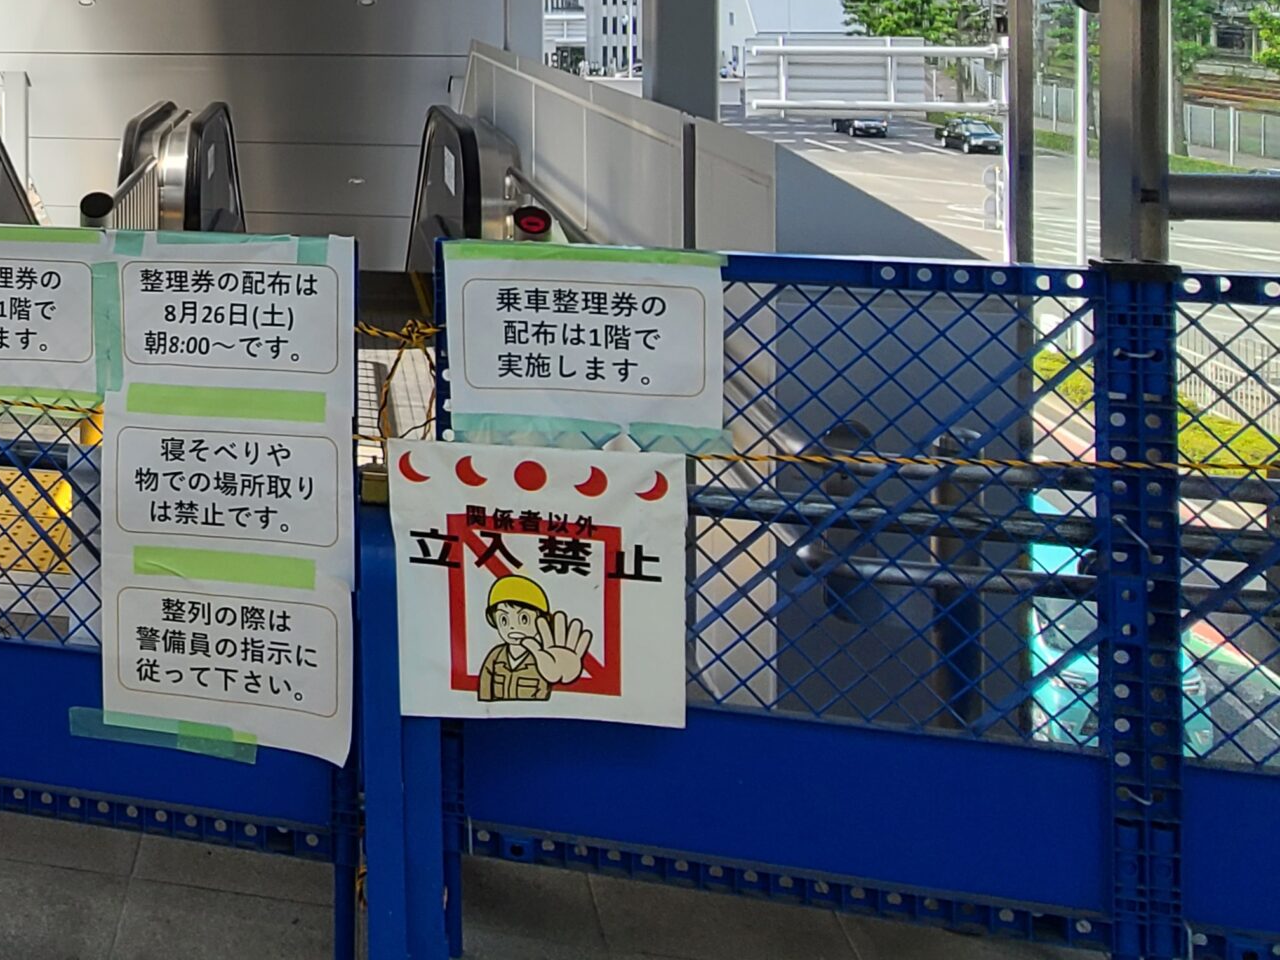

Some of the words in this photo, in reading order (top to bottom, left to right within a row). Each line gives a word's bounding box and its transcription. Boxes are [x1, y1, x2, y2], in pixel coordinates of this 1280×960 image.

[140, 268, 319, 296] 整理券の配布は
[164, 300, 294, 331] 8月26日(土)
[496, 287, 667, 318] 乗車整理券の
[503, 320, 661, 351] 配布は1階で
[497, 352, 651, 386] 実施します。
[160, 437, 291, 467] 寝そべりや
[135, 467, 314, 500] 物での場所取り
[150, 499, 289, 533] は禁止です。
[465, 504, 598, 536] 関係者以外
[409, 528, 663, 583] 立入禁止
[161, 597, 292, 632] 整列の際は
[135, 626, 318, 669] 警備員の指示に
[135, 657, 303, 702] 従って下さい。
